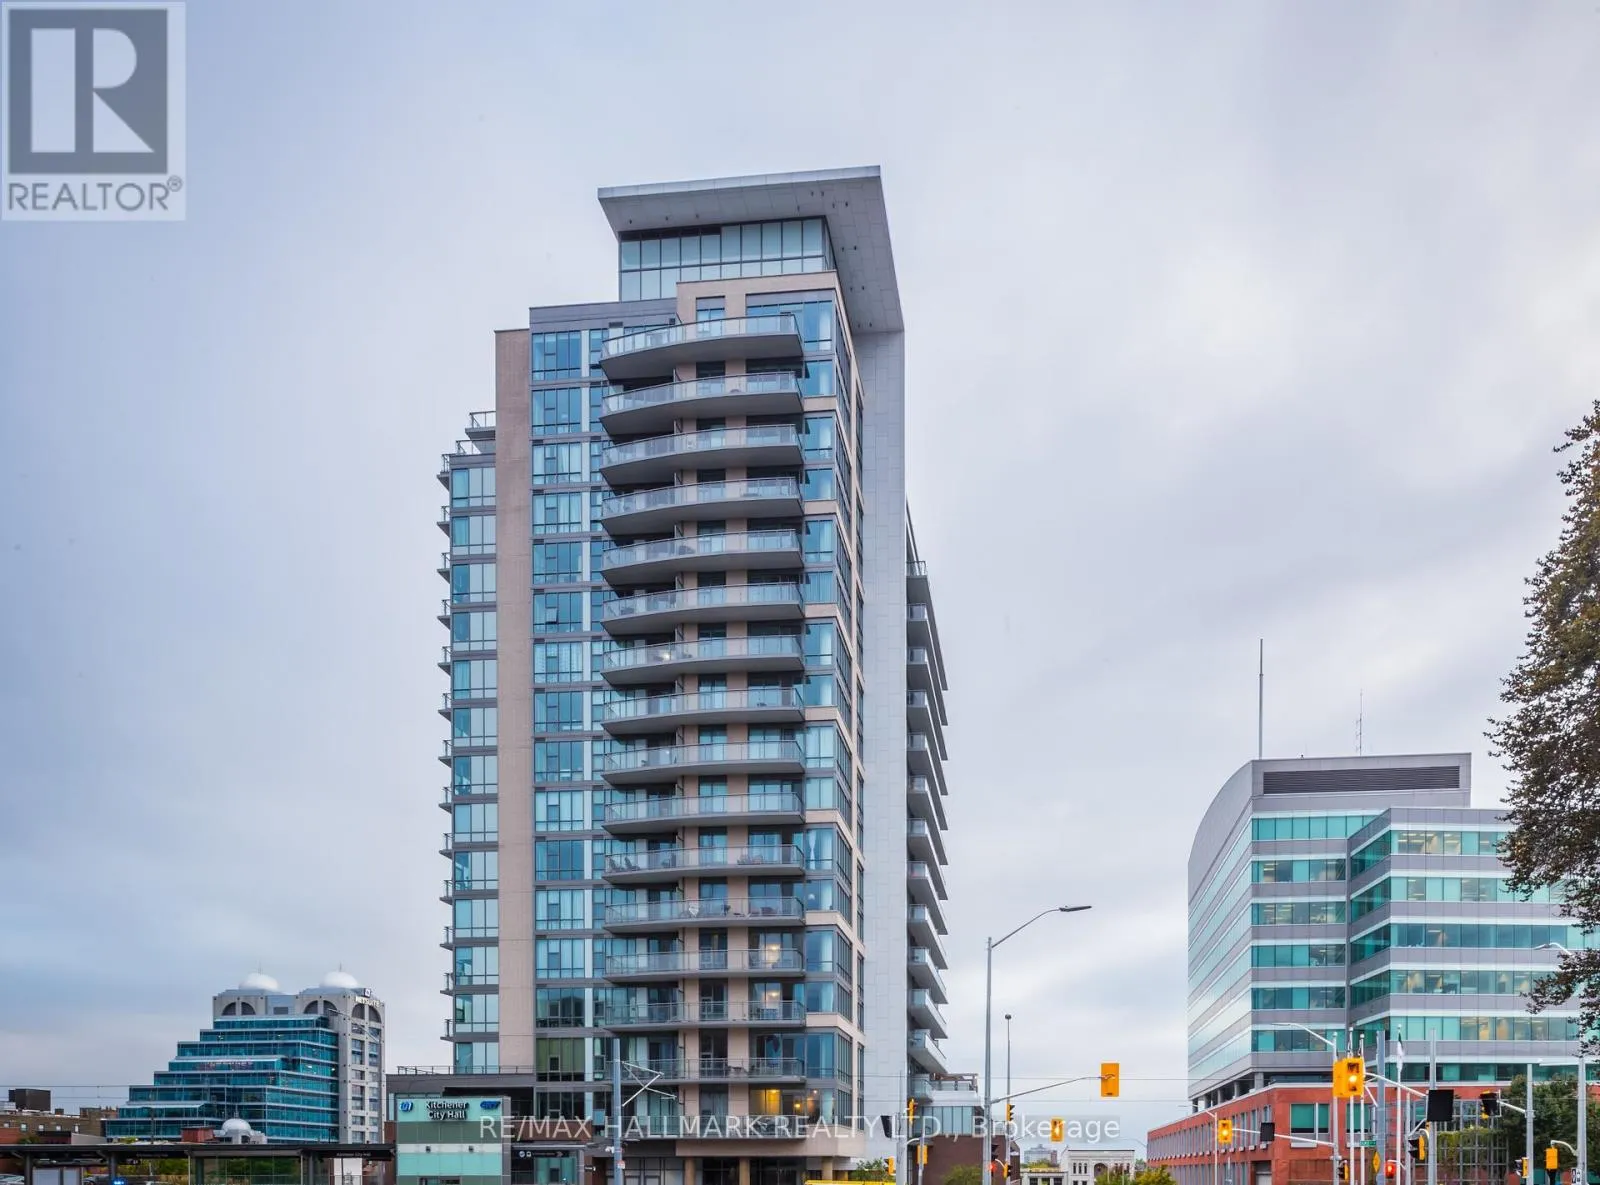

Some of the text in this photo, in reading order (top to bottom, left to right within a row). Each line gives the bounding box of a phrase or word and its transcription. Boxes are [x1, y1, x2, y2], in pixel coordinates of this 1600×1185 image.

[426, 1100, 467, 1109] Kitchener
[428, 1110, 466, 1121] City Hall
